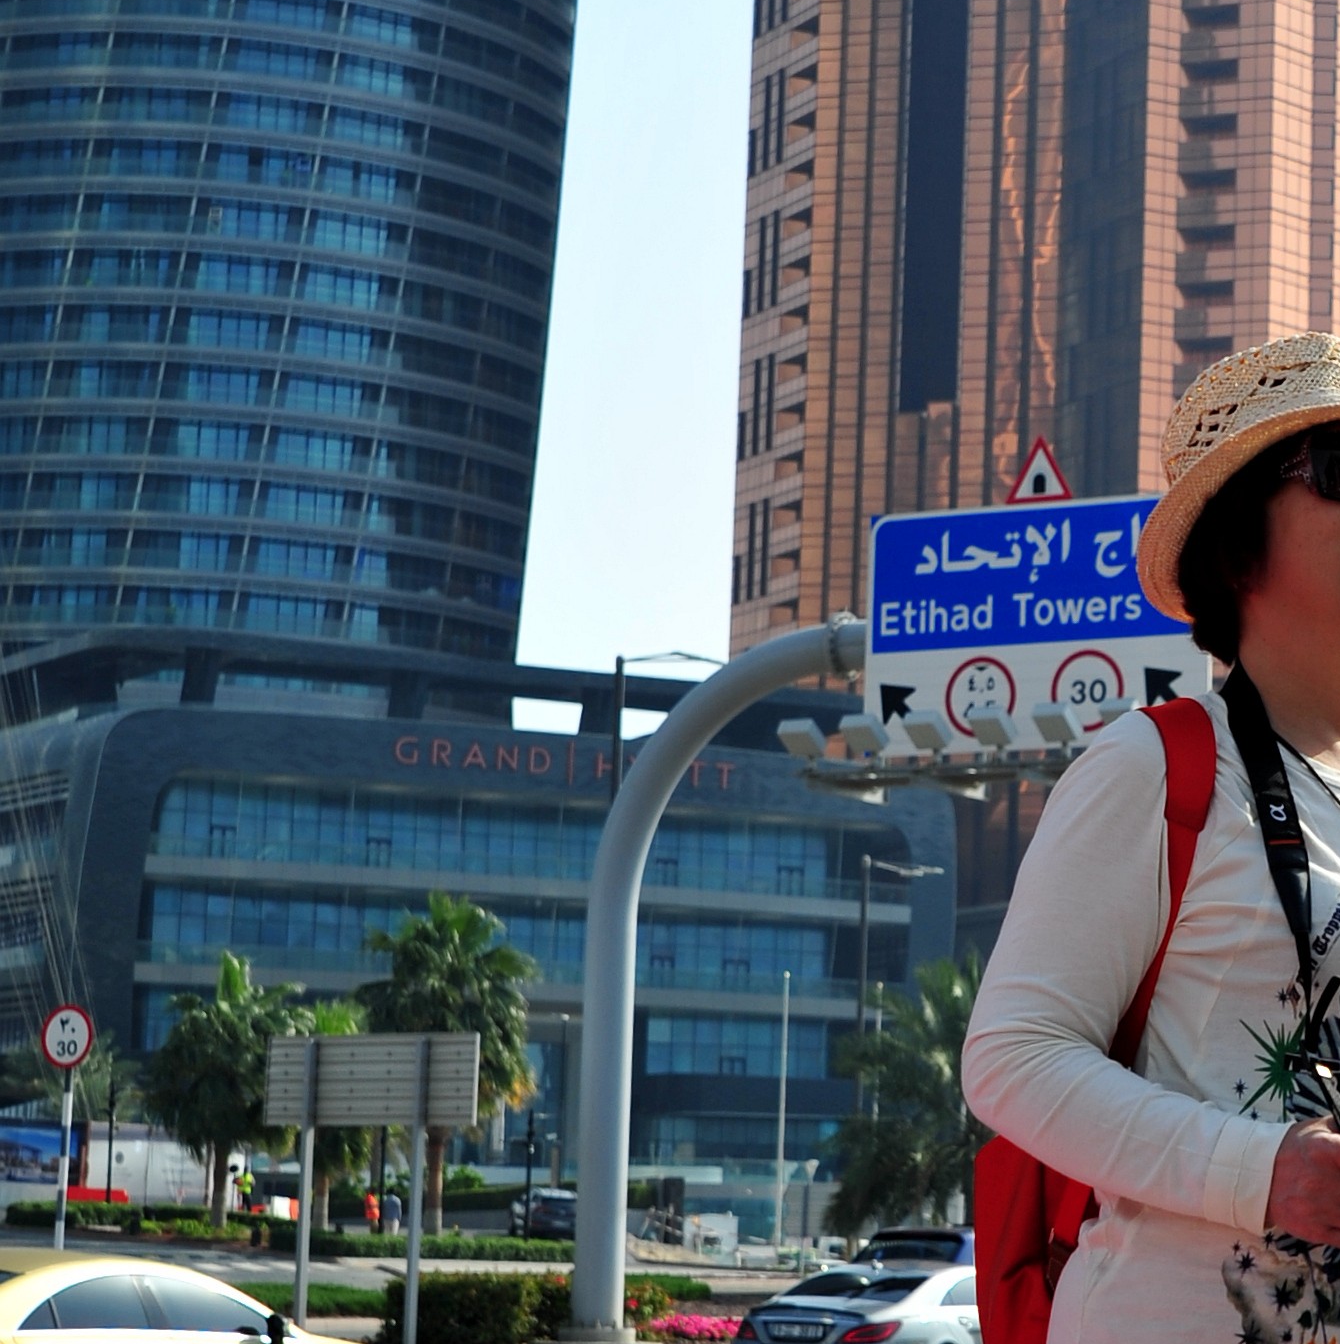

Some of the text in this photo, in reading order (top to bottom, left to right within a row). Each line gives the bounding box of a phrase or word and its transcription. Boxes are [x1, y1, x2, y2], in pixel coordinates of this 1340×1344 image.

[915, 518, 1070, 583] الإتحاد
[880, 592, 1142, 637] Etihad Towers
[1071, 679, 1107, 704] 30
[394, 736, 736, 790] GRAND HTT
[56, 1039, 78, 1057] 30
